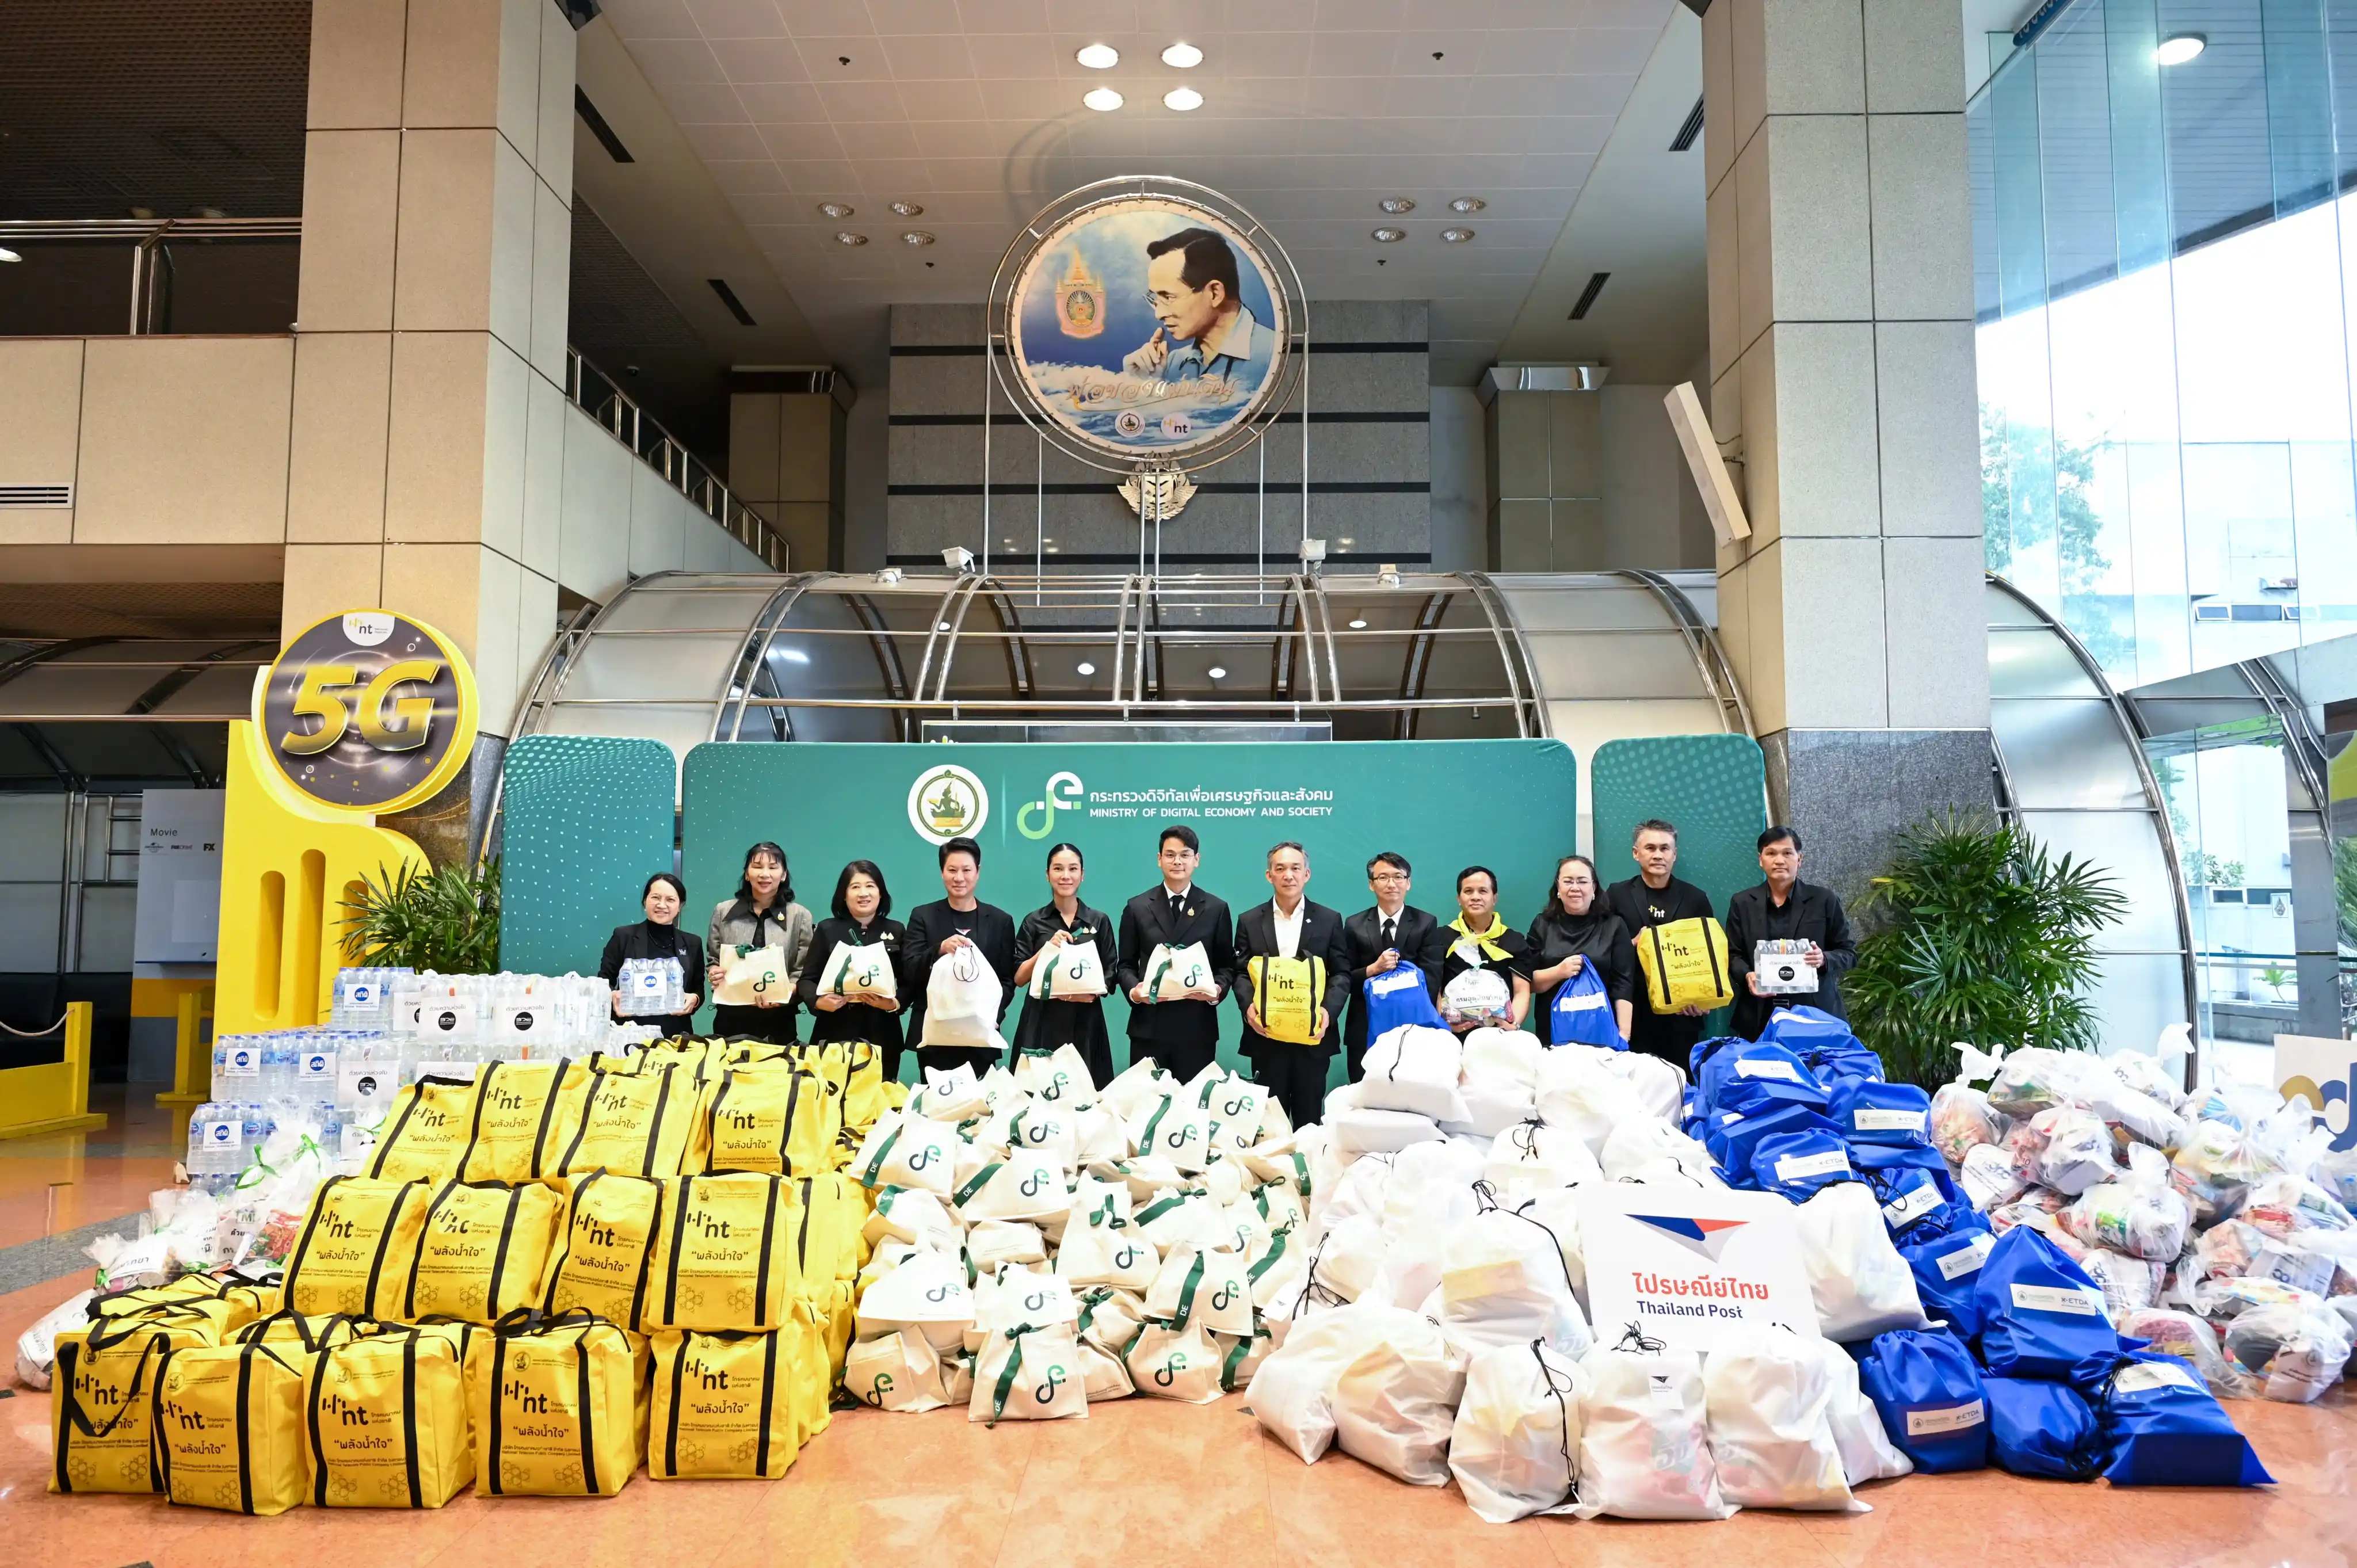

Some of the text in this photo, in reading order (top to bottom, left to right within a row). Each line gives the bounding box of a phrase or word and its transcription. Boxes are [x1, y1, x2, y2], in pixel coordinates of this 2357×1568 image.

[1174, 425, 1187, 433] nt
[359, 624, 373, 634] nt
[281, 660, 440, 755] 5G
[1090, 784, 1333, 804] กระทรวงดิจิทัลเพื่อเศรษฐกิจและสังคม
[1089, 806, 1333, 818] MINISTRY OF DIGITAL ECONOMY AND SOCIETY
[150, 828, 178, 836] Movie
[203, 843, 215, 851] FX
[1654, 909, 1665, 918] nt
[1675, 946, 1689, 956] nt
[1044, 981, 1050, 989] DE
[1151, 985, 1157, 993] DE
[1280, 979, 1294, 989] nt
[499, 1095, 522, 1109] nt
[608, 1096, 627, 1111] nt
[425, 1113, 445, 1126] nt
[734, 1113, 755, 1129] nt
[1143, 1139, 1150, 1149] DE
[869, 1162, 878, 1173] DE
[963, 1185, 974, 1197] DE
[330, 1220, 353, 1238] nt
[705, 1221, 730, 1238] nt
[590, 1229, 615, 1246] nt
[1632, 1272, 1769, 1300] ไปรษณีย์ไทย
[1180, 1304, 1188, 1317] DE
[1637, 1300, 1744, 1318] Thailand Post
[703, 1371, 728, 1390] nt
[95, 1385, 119, 1405] nt
[523, 1394, 547, 1413] nt
[994, 1399, 1001, 1411] DE
[180, 1411, 204, 1429] nt
[342, 1406, 368, 1425] nt
